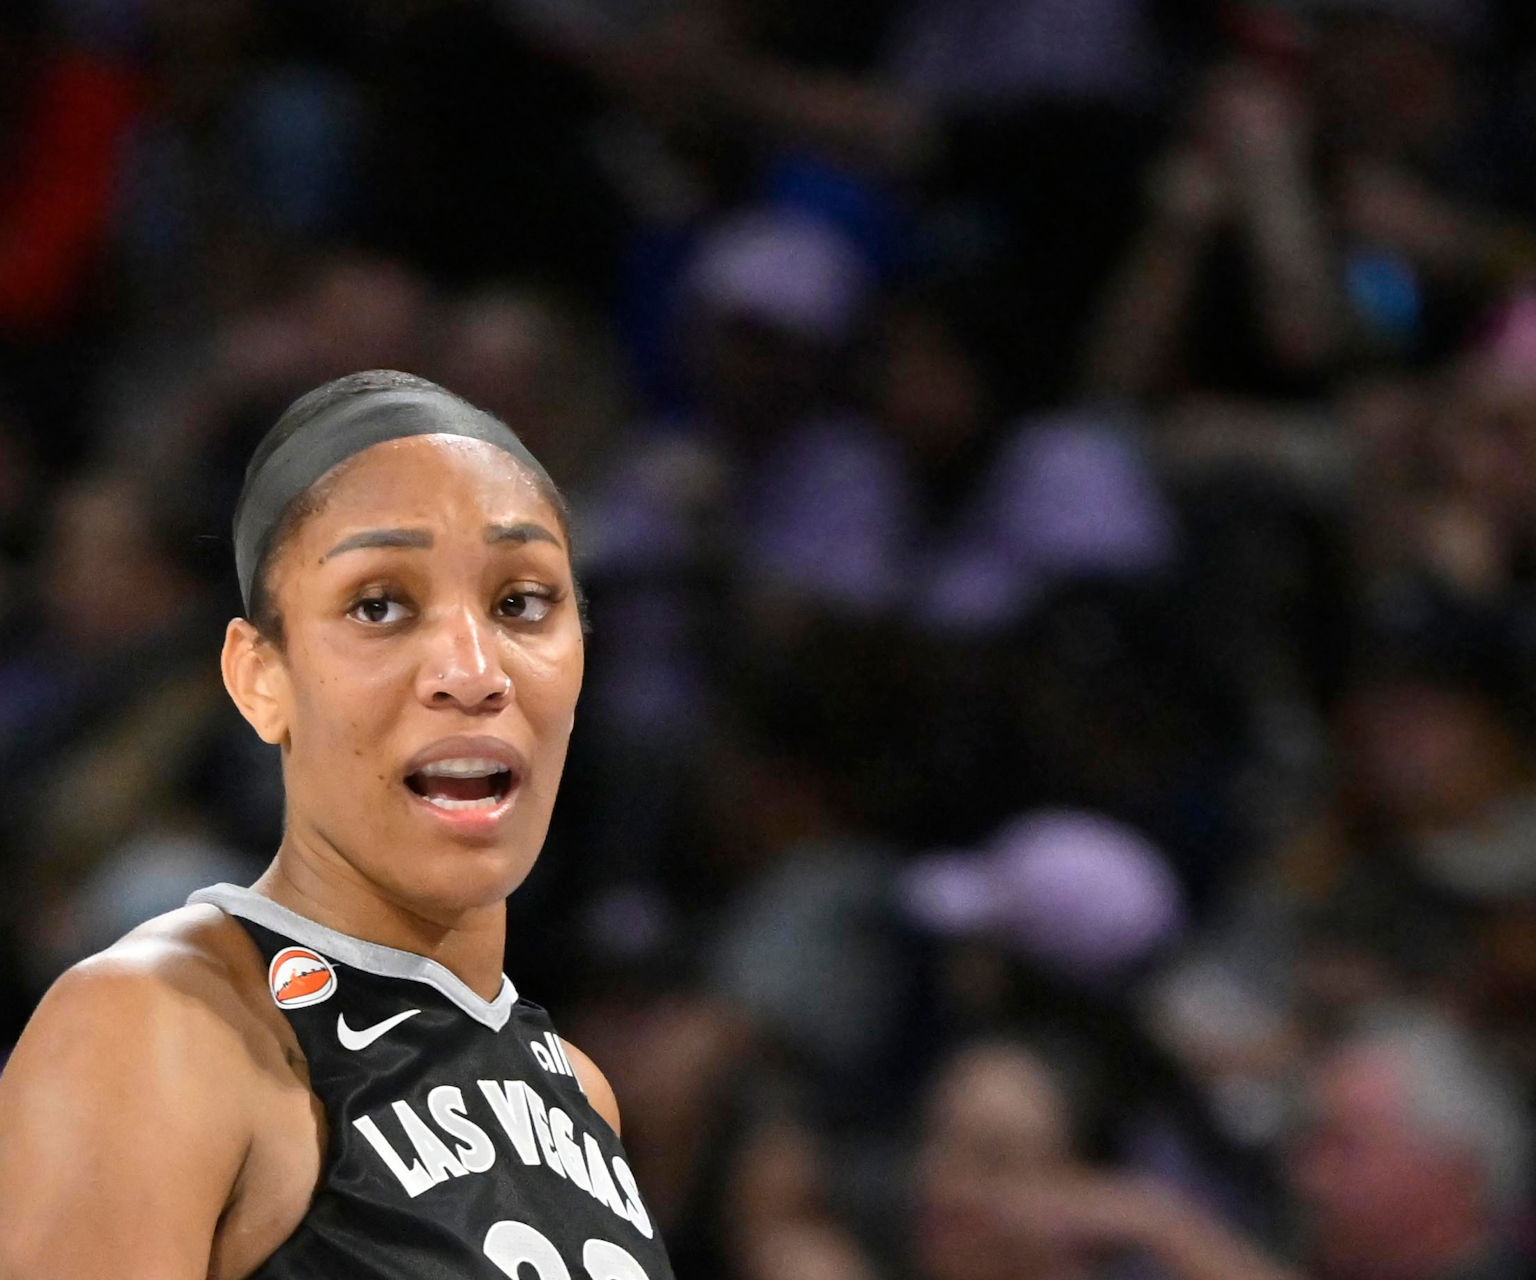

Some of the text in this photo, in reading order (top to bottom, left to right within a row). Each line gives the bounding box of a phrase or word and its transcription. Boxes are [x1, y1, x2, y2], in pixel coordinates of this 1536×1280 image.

[529, 1031, 584, 1093] all
[352, 1080, 654, 1240] LAS VEGAS
